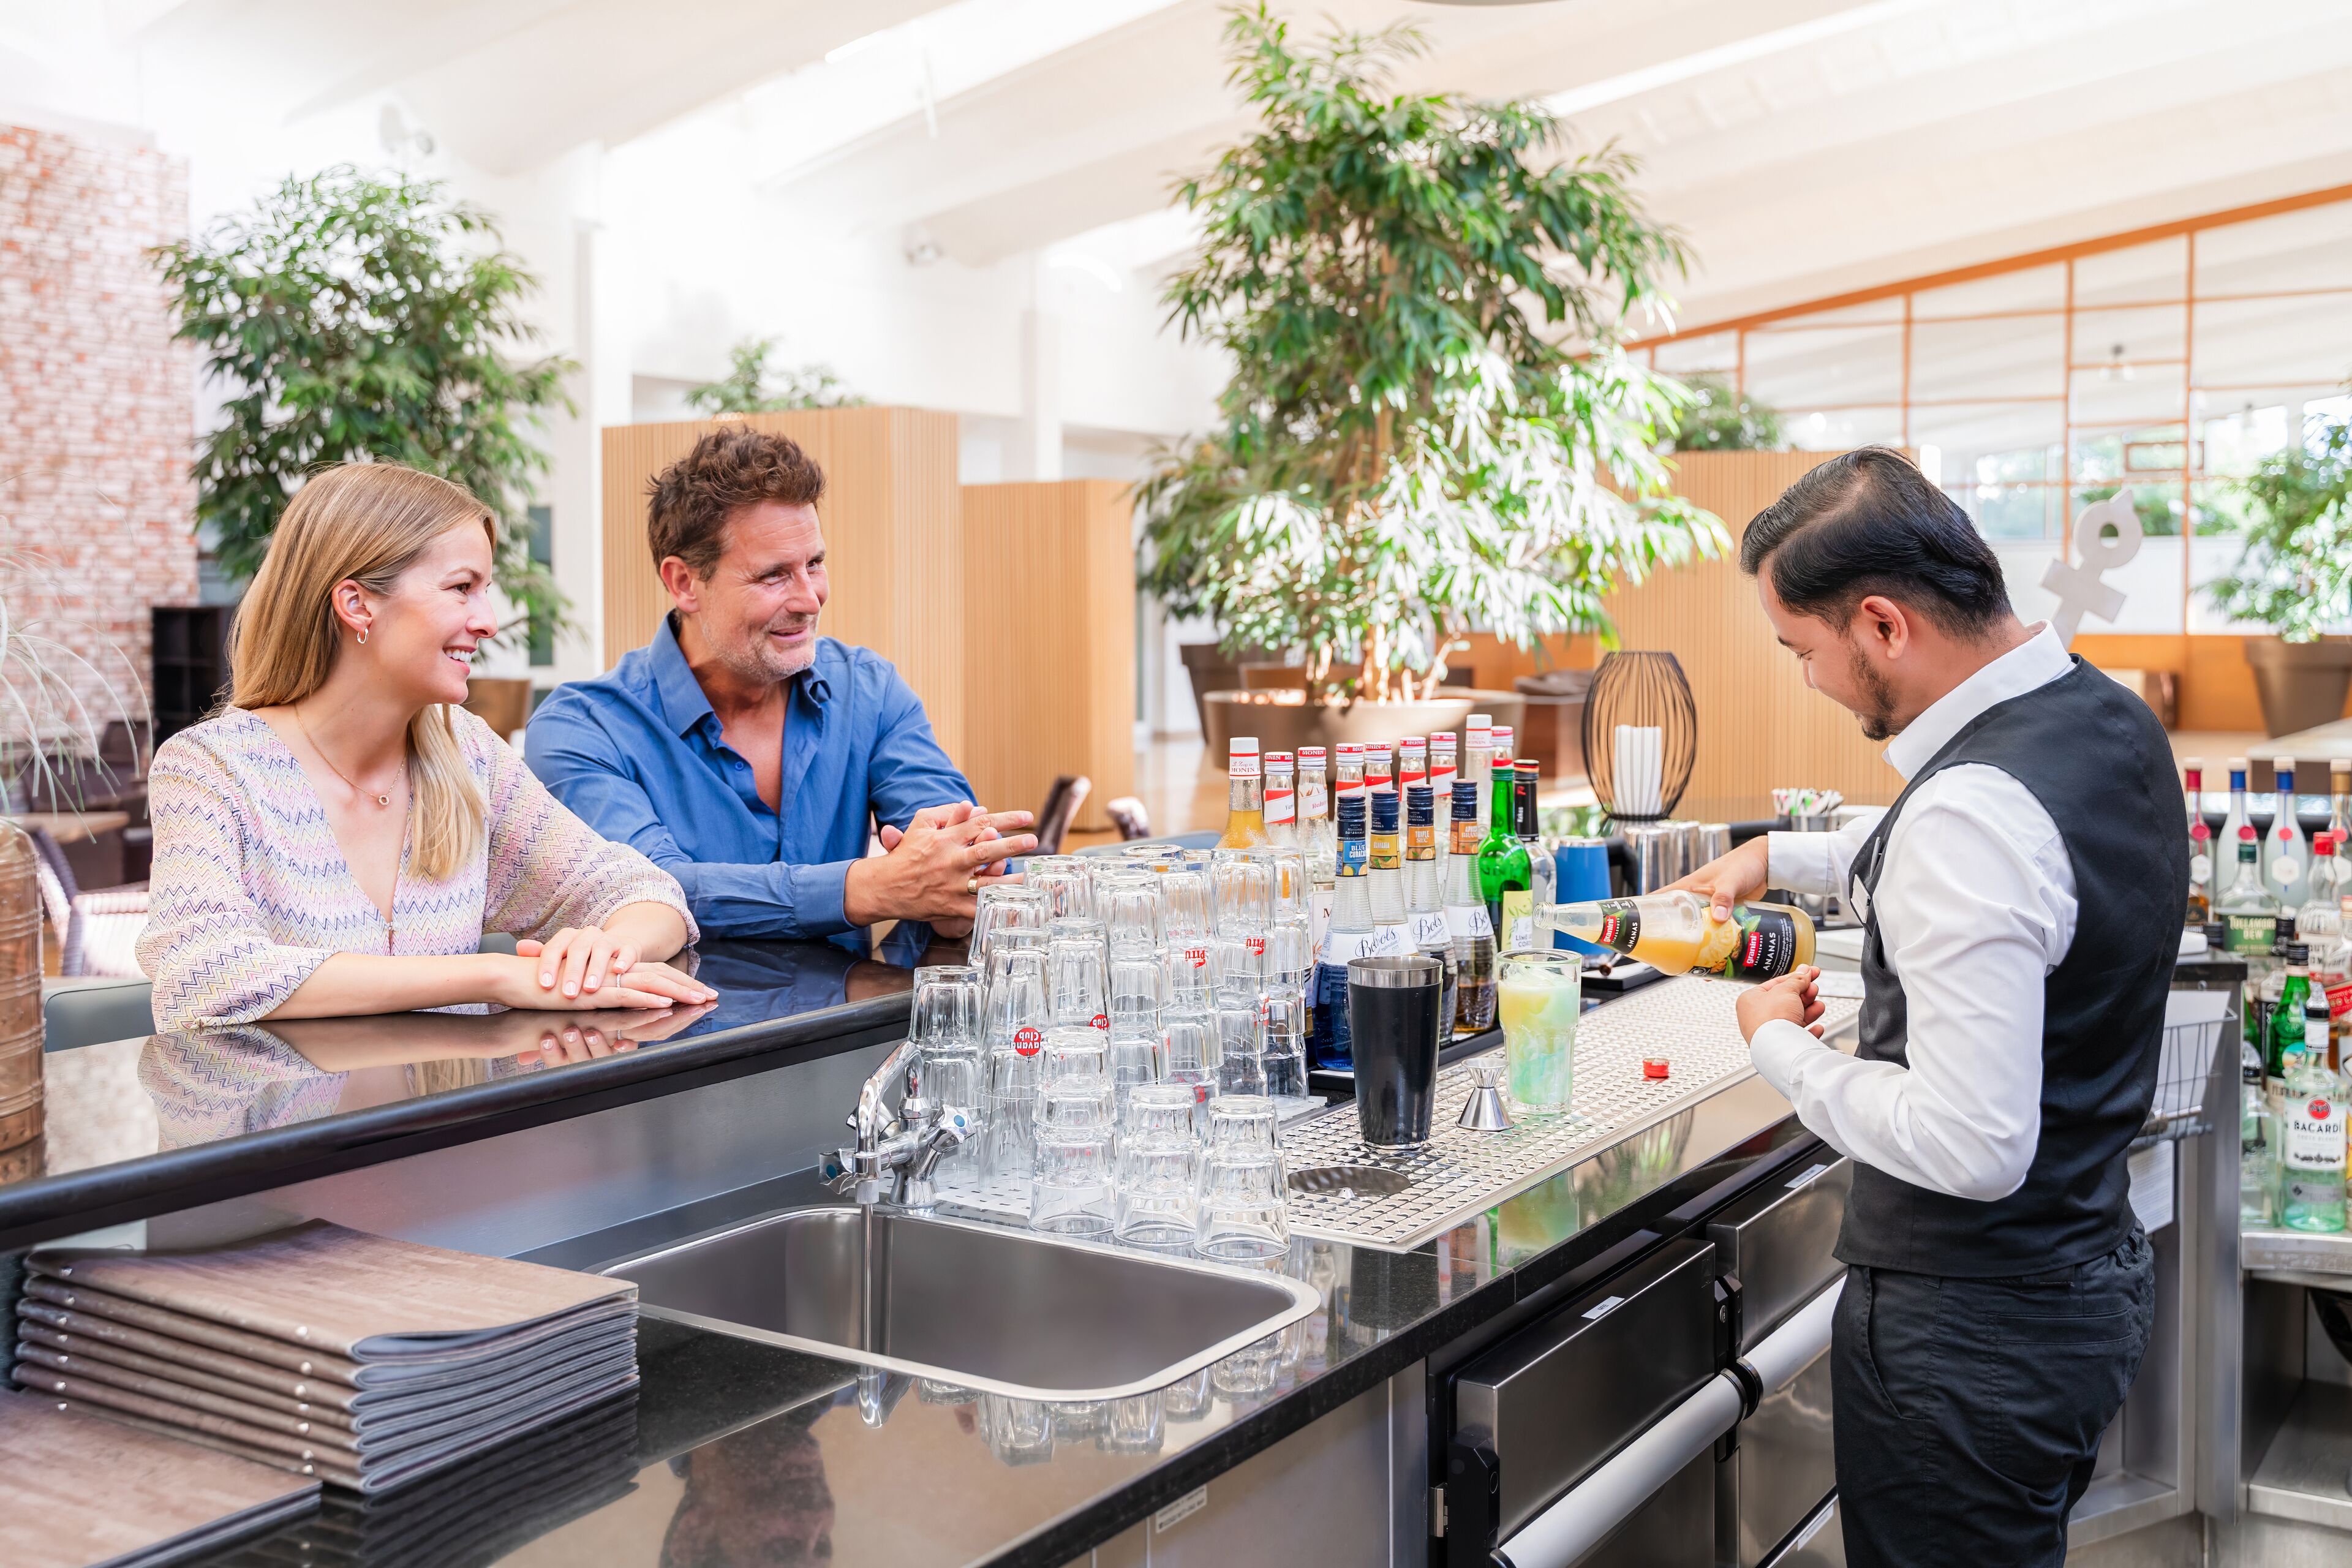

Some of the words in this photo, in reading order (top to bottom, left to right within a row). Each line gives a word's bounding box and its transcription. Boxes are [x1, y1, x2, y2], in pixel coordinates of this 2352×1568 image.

[1412, 913, 1442, 944] Bols
[1603, 918, 1615, 943] granini
[1627, 922, 1638, 948] ANANAS
[1746, 935, 1757, 964] granini
[1763, 932, 1777, 971] ANANAS
[1093, 1017, 1107, 1027] Club
[1019, 1031, 1039, 1041] Club
[2294, 1119, 2342, 1133] BACARDÍ
